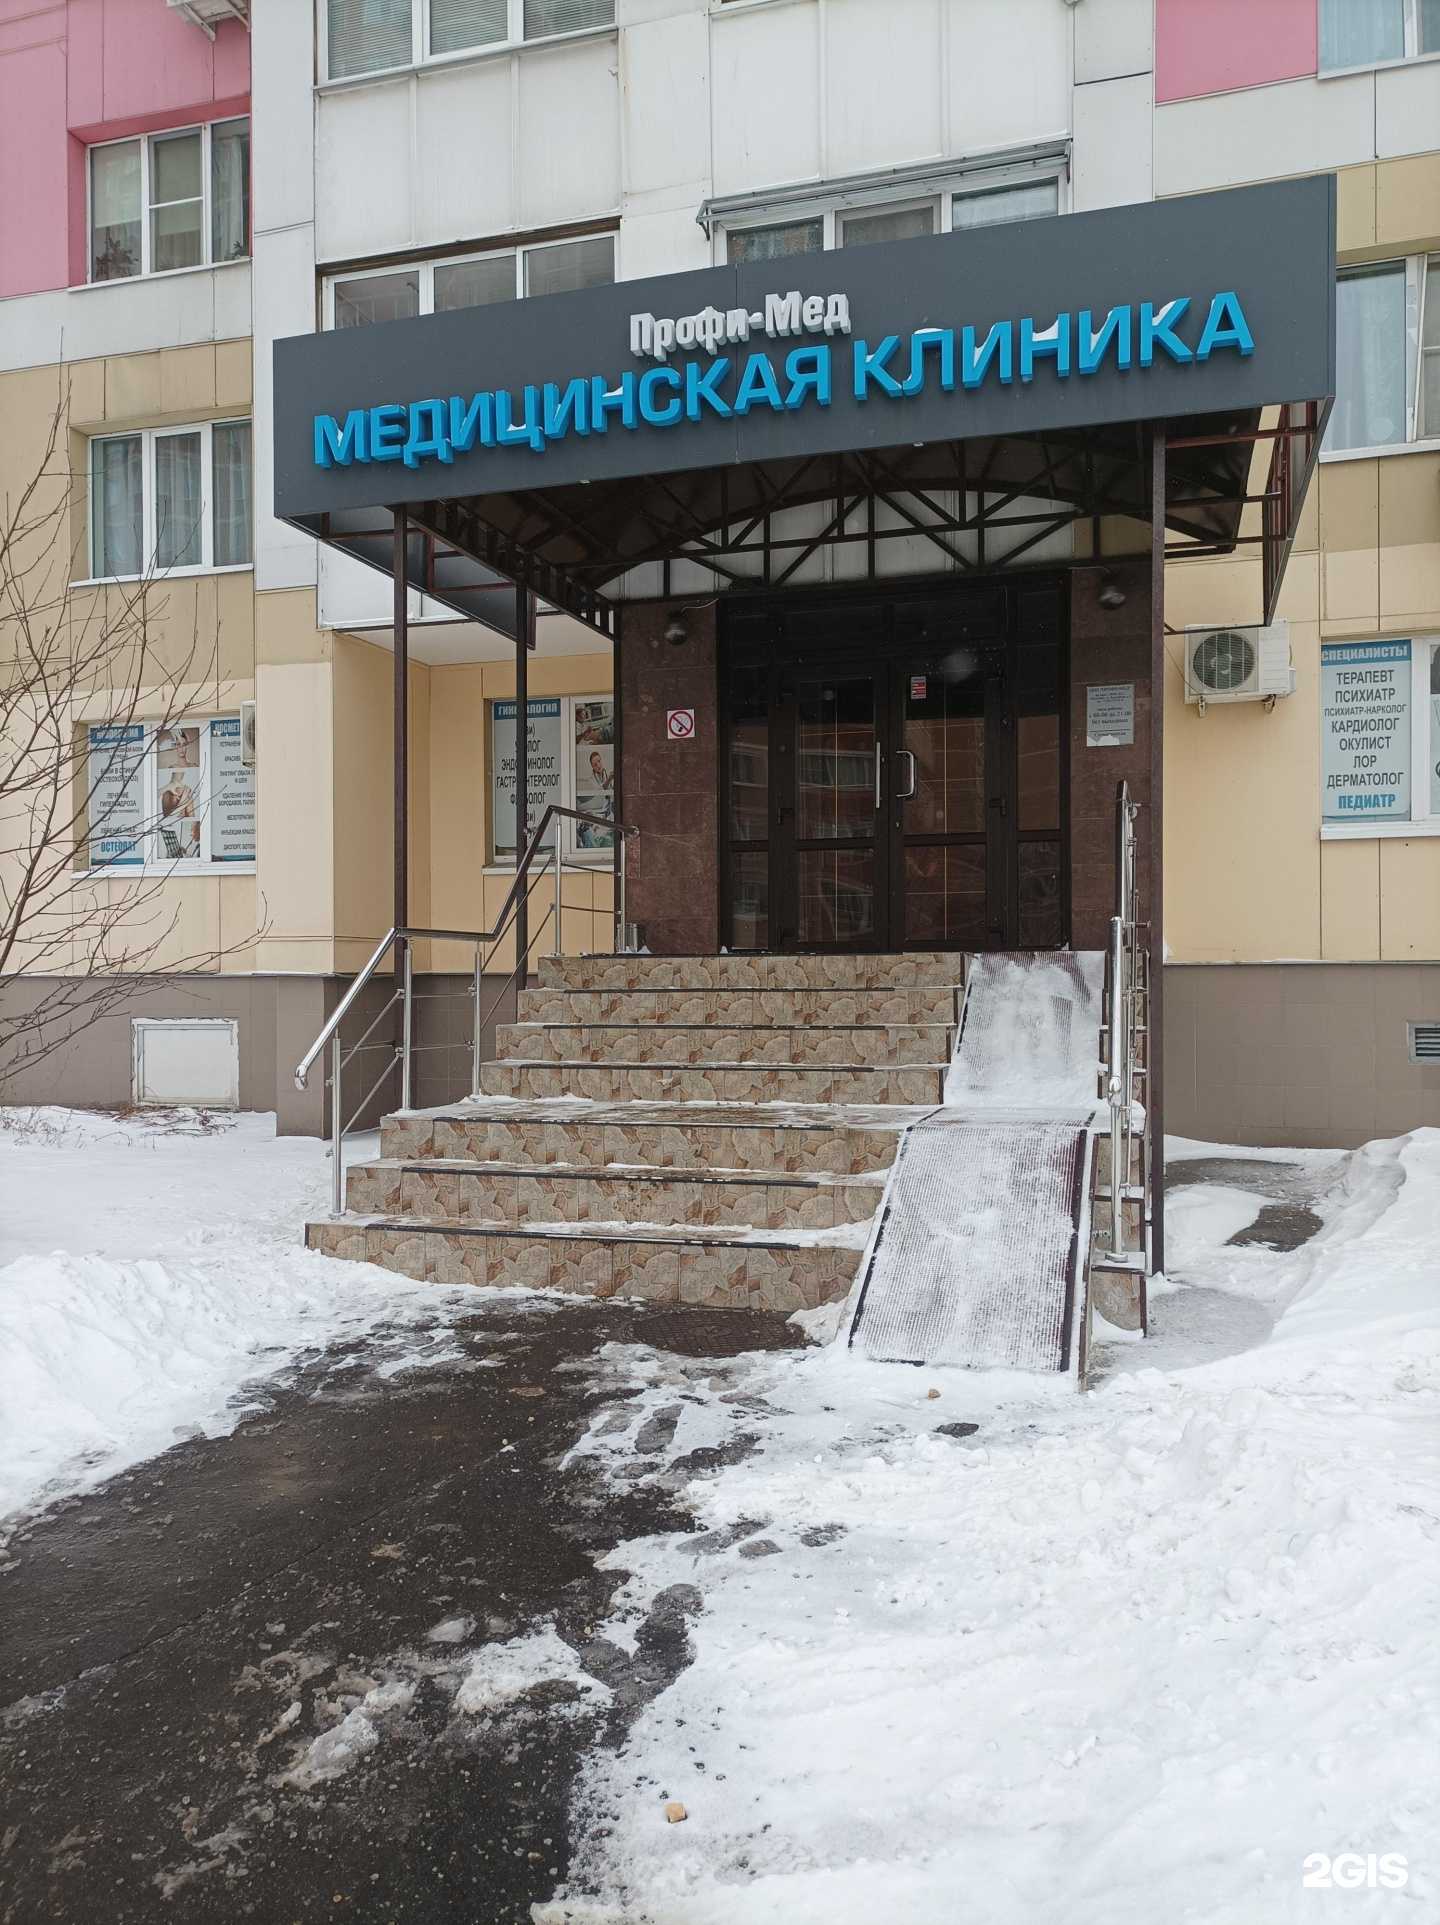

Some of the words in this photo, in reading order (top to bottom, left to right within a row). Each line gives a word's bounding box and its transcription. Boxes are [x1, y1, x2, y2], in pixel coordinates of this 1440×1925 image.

[630, 291, 852, 362] Профи-Мед
[314, 345, 832, 469] МЕДИЦИНСКАЯ
[853, 291, 1256, 401] КЛИНИКА
[1321, 645, 1408, 662] СПЕЦИАЛИСТЫ
[1336, 669, 1395, 685] ТЕРАПЕВТ
[1335, 688, 1396, 703] ПСИХИАТР
[498, 702, 558, 716] ГИНЛОГИЯ
[1324, 704, 1407, 717] ПСИХИАТР-НАРКОЛОГ
[1331, 718, 1400, 734] КАРДИОЛОГ
[1339, 736, 1392, 751] ОКУЛИСТ
[501, 757, 555, 771] ЭНДИНОЛОГ
[1353, 755, 1377, 769] ЛОР
[496, 774, 560, 789] ГАСТРТЕРОЛОГ
[1327, 772, 1405, 789] ДЕРМАТОЛОГ
[1338, 794, 1396, 812] ПЕДИАТР
